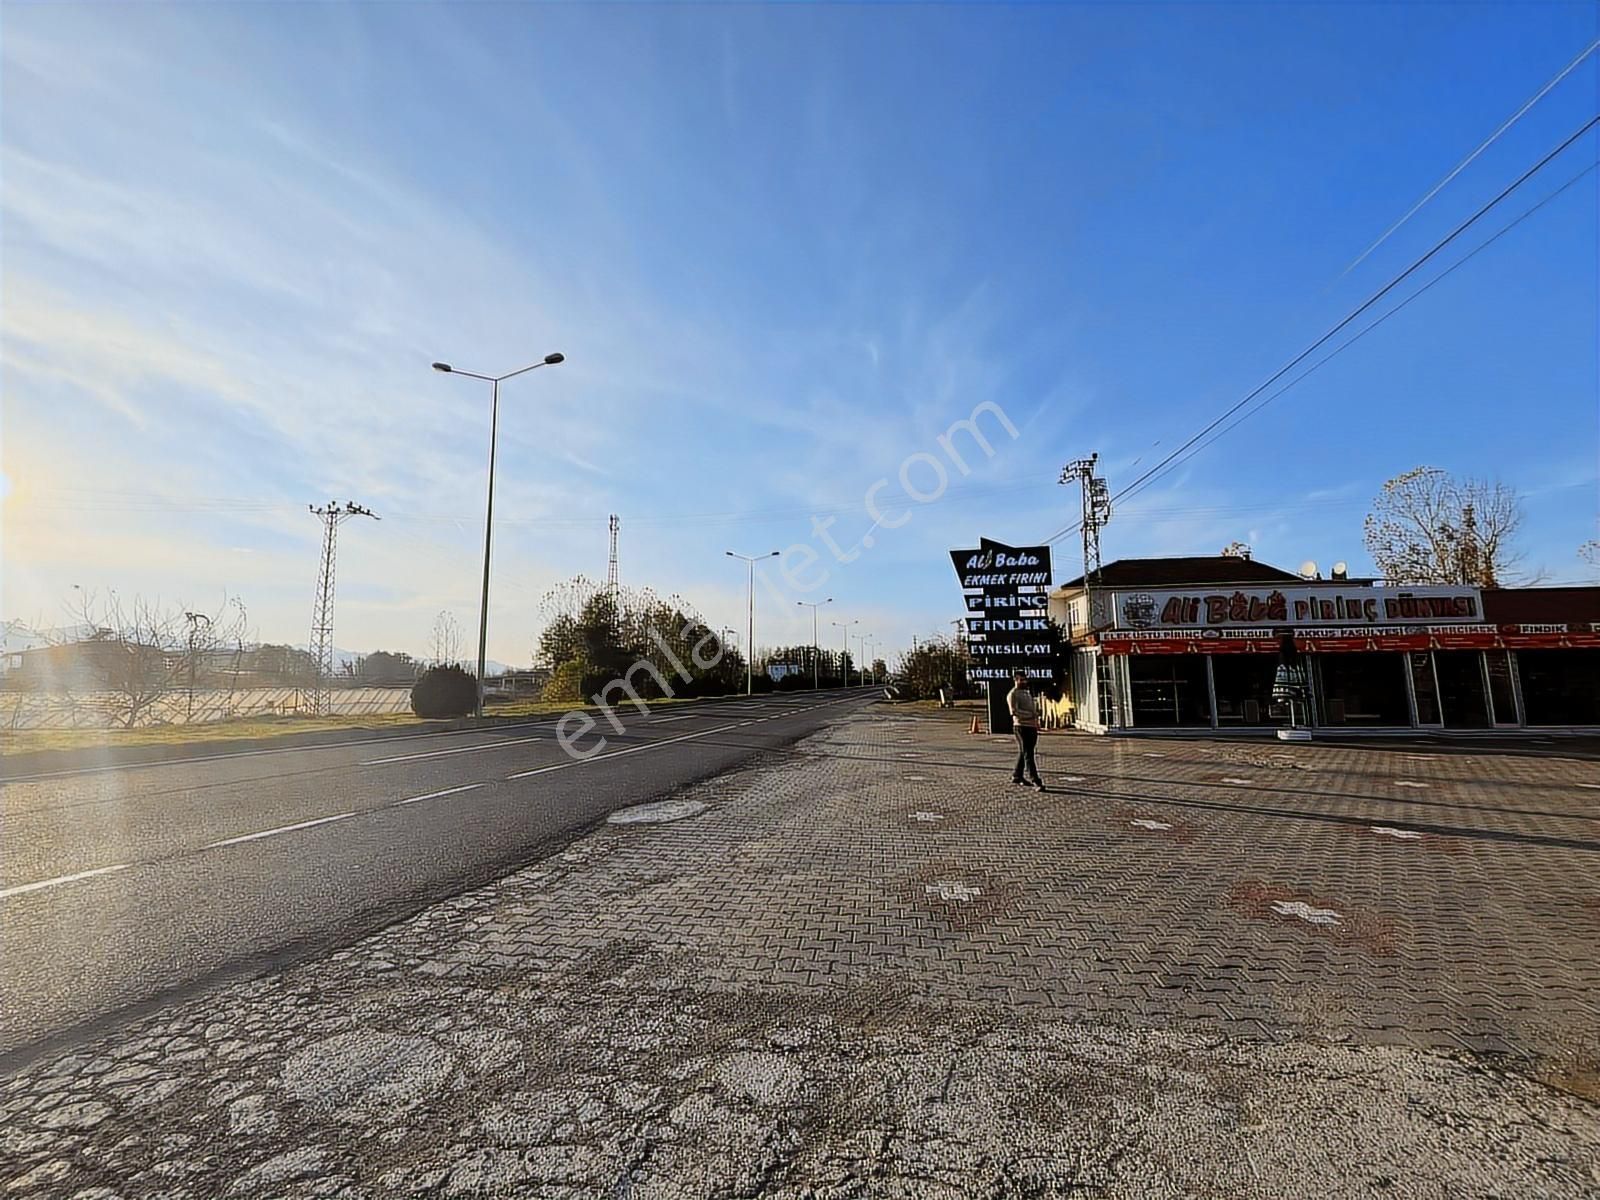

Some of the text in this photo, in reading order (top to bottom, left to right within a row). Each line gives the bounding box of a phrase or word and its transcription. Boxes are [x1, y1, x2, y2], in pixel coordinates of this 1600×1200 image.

[995, 553, 1039, 568] Baba
[964, 573, 1047, 586] EKMEK FIRINI
[969, 594, 1048, 608] PİRİNÇ
[1160, 596, 1202, 625] Ali
[1293, 594, 1377, 623] PİRİNÇ
[1385, 593, 1475, 618] DÜNYASI
[970, 619, 1049, 631] FINDIK
[1520, 624, 1566, 633] FINDIK
[1024, 643, 1051, 656] ÇAYI
[1012, 666, 1053, 679] ÜÜNLER
